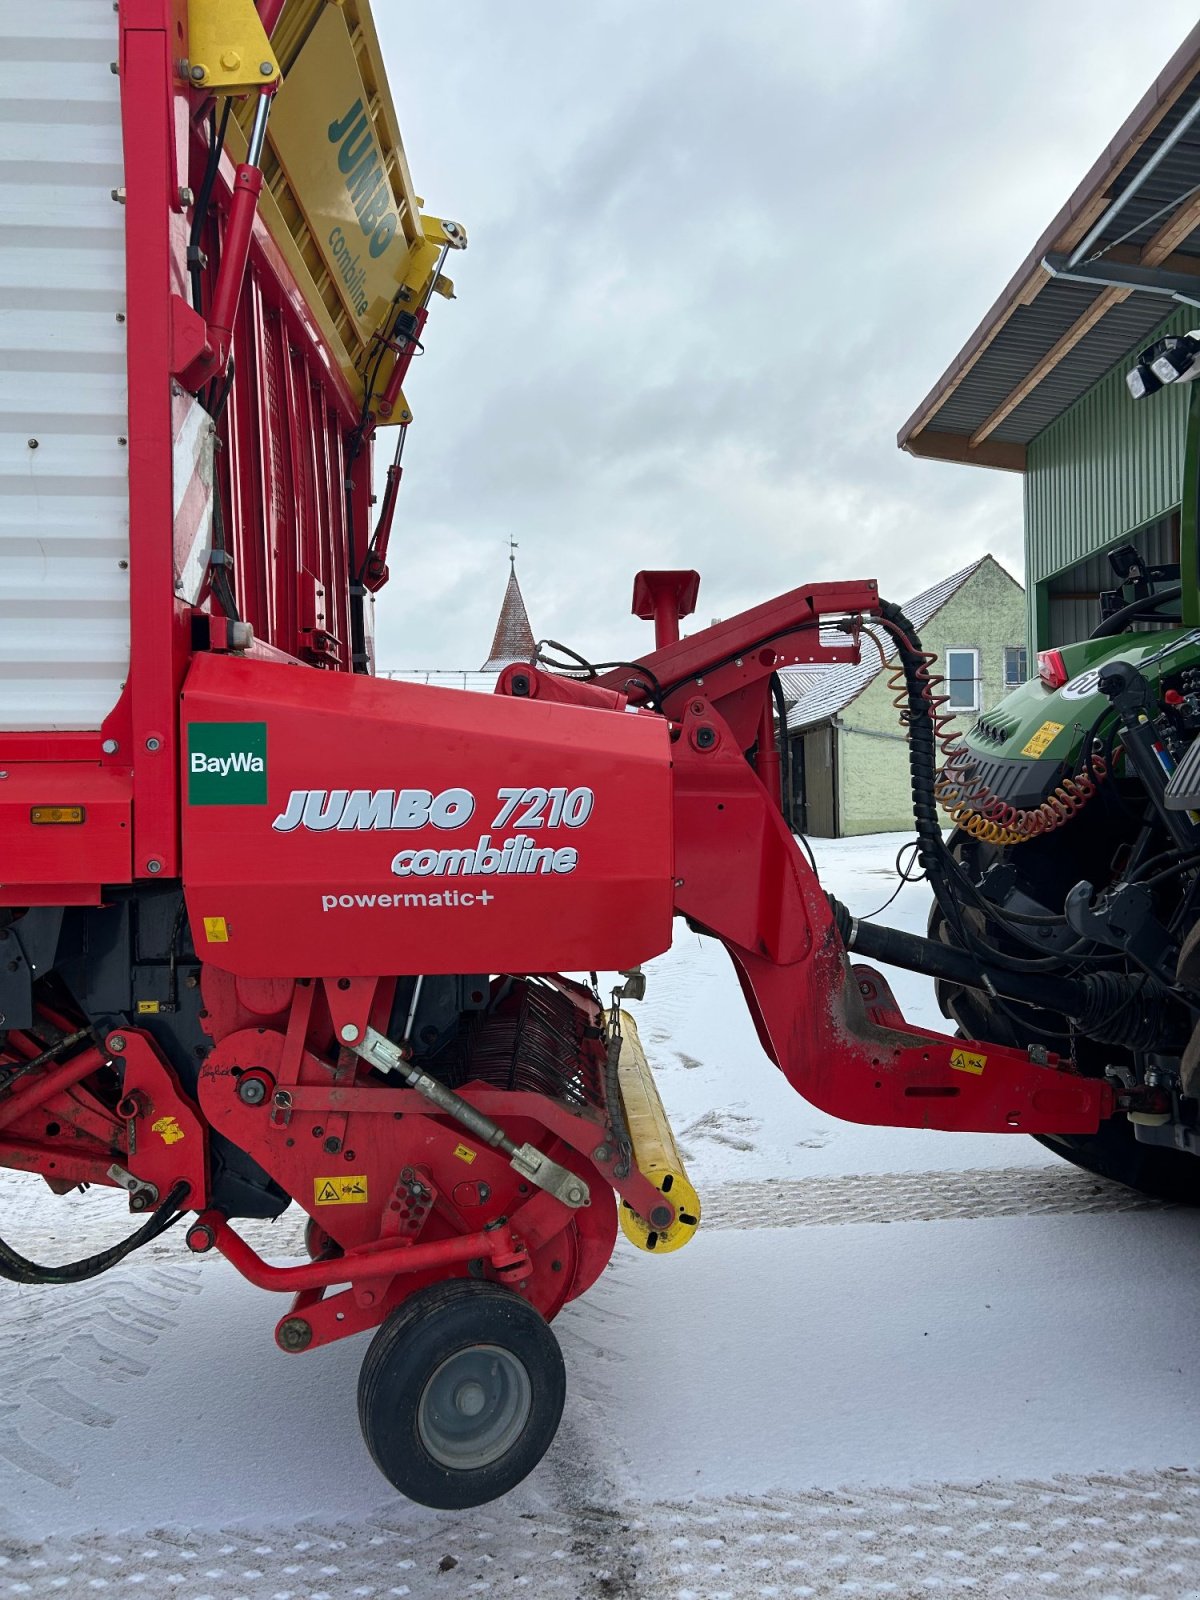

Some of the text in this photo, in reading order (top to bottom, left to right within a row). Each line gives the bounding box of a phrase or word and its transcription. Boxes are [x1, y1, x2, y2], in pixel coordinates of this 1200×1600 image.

[328, 97, 397, 259] JUMBO
[328, 226, 369, 317] combiline
[191, 752, 264, 777] BayWa
[272, 786, 594, 832] JUMBO 7210
[391, 834, 578, 877] combiline
[321, 889, 495, 912] powermatic+
